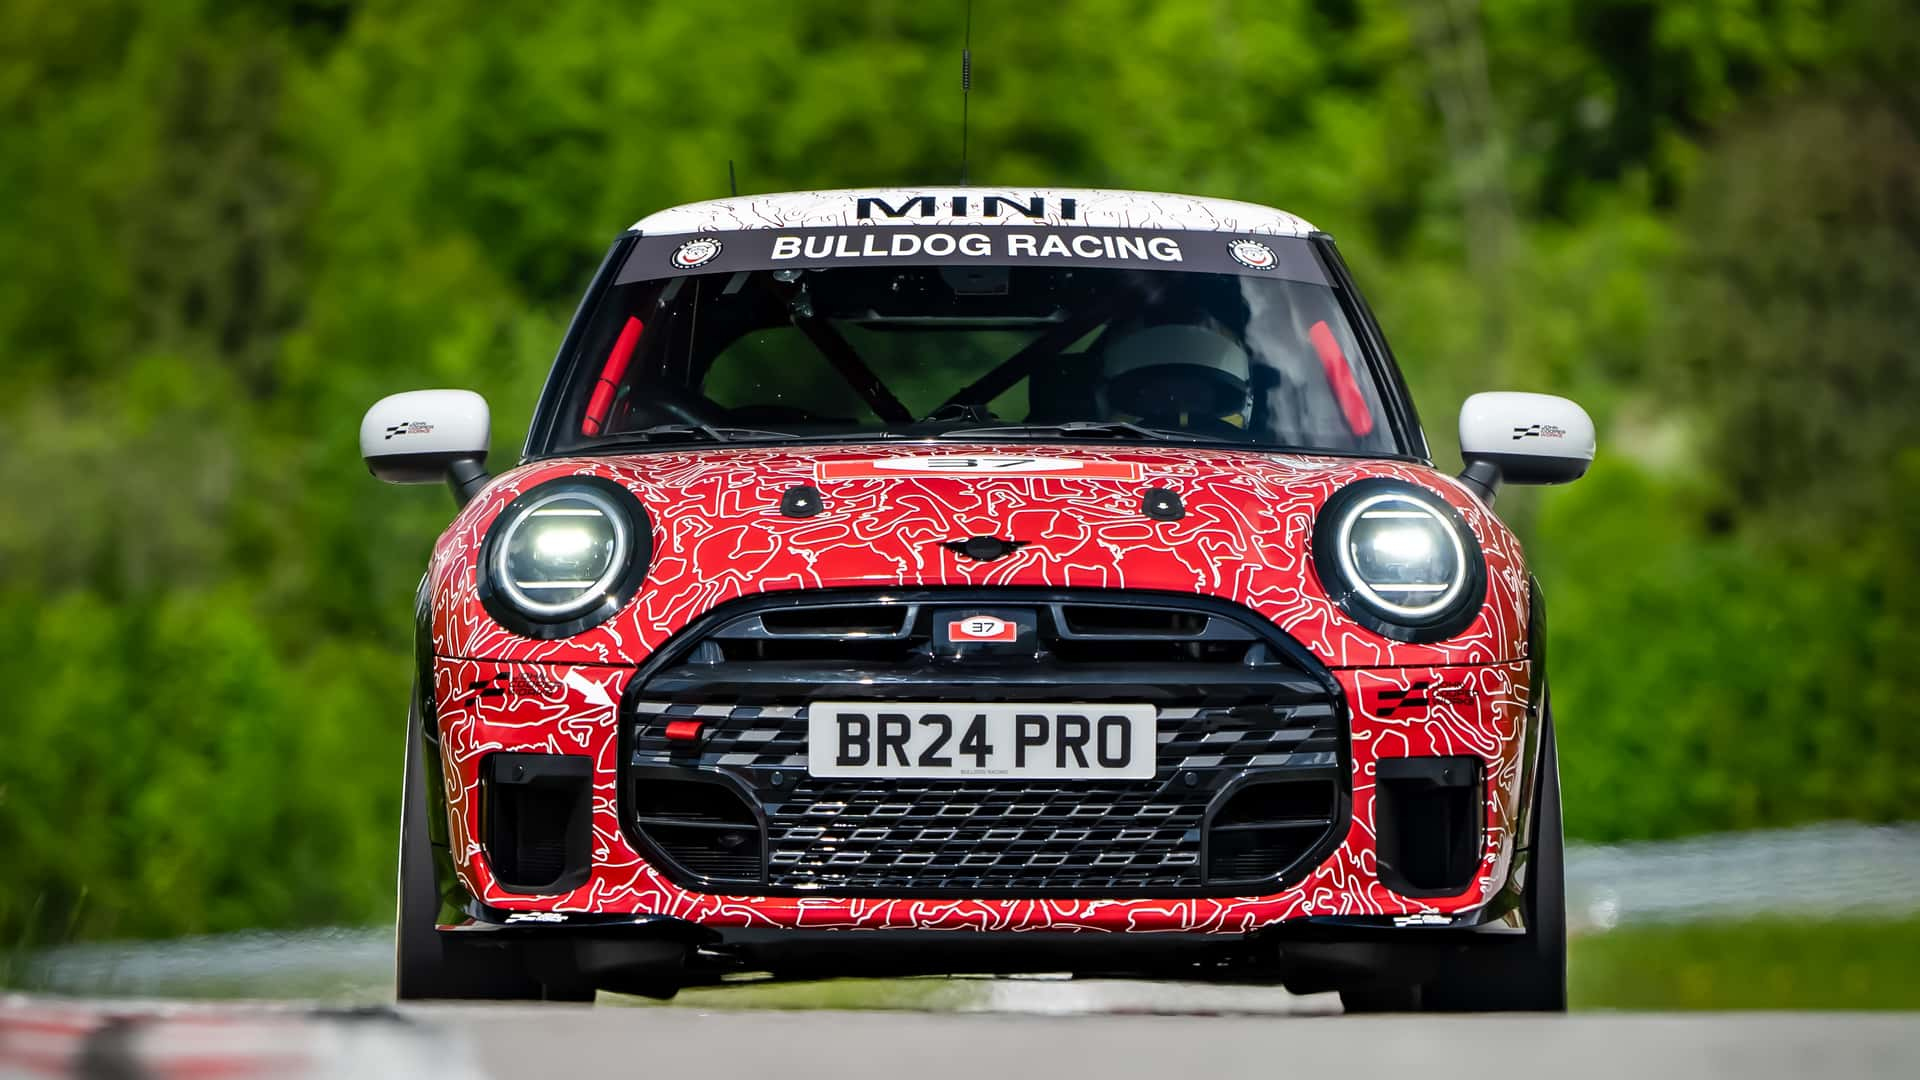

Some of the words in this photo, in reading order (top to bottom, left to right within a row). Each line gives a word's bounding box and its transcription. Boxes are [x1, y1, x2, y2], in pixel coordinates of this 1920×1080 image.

[857, 196, 1076, 220] MINI
[771, 233, 992, 260] BULLDOG
[1007, 233, 1183, 262] RACING
[927, 458, 1035, 468] 37
[972, 622, 995, 632] 37
[836, 713, 993, 768] BR24
[1015, 714, 1131, 768] PRO
